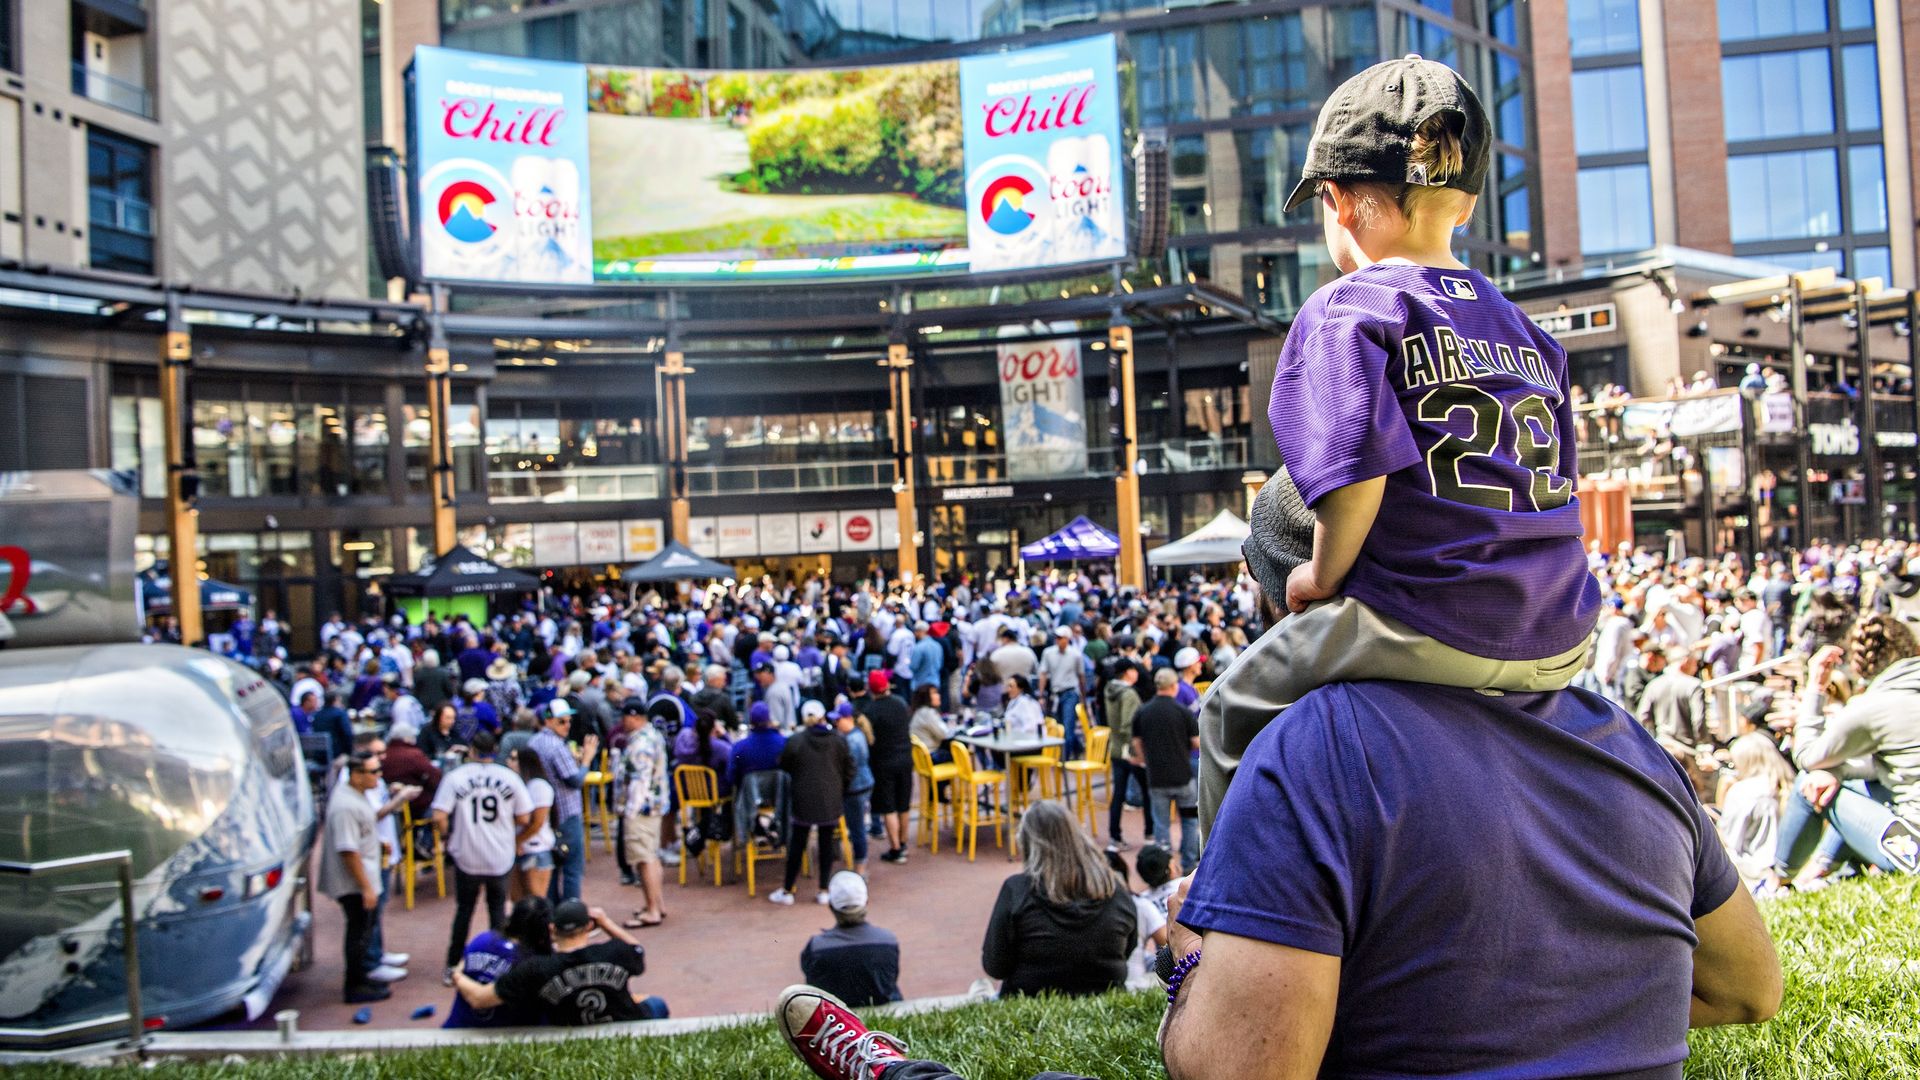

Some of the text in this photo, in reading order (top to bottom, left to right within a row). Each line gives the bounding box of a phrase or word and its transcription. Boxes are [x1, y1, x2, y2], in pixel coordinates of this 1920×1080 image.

[440, 98, 565, 147] Chill
[982, 84, 1096, 138] Chill
[1000, 345, 1078, 382] oors
[471, 795, 498, 824] 19
[576, 988, 614, 1025] 2
